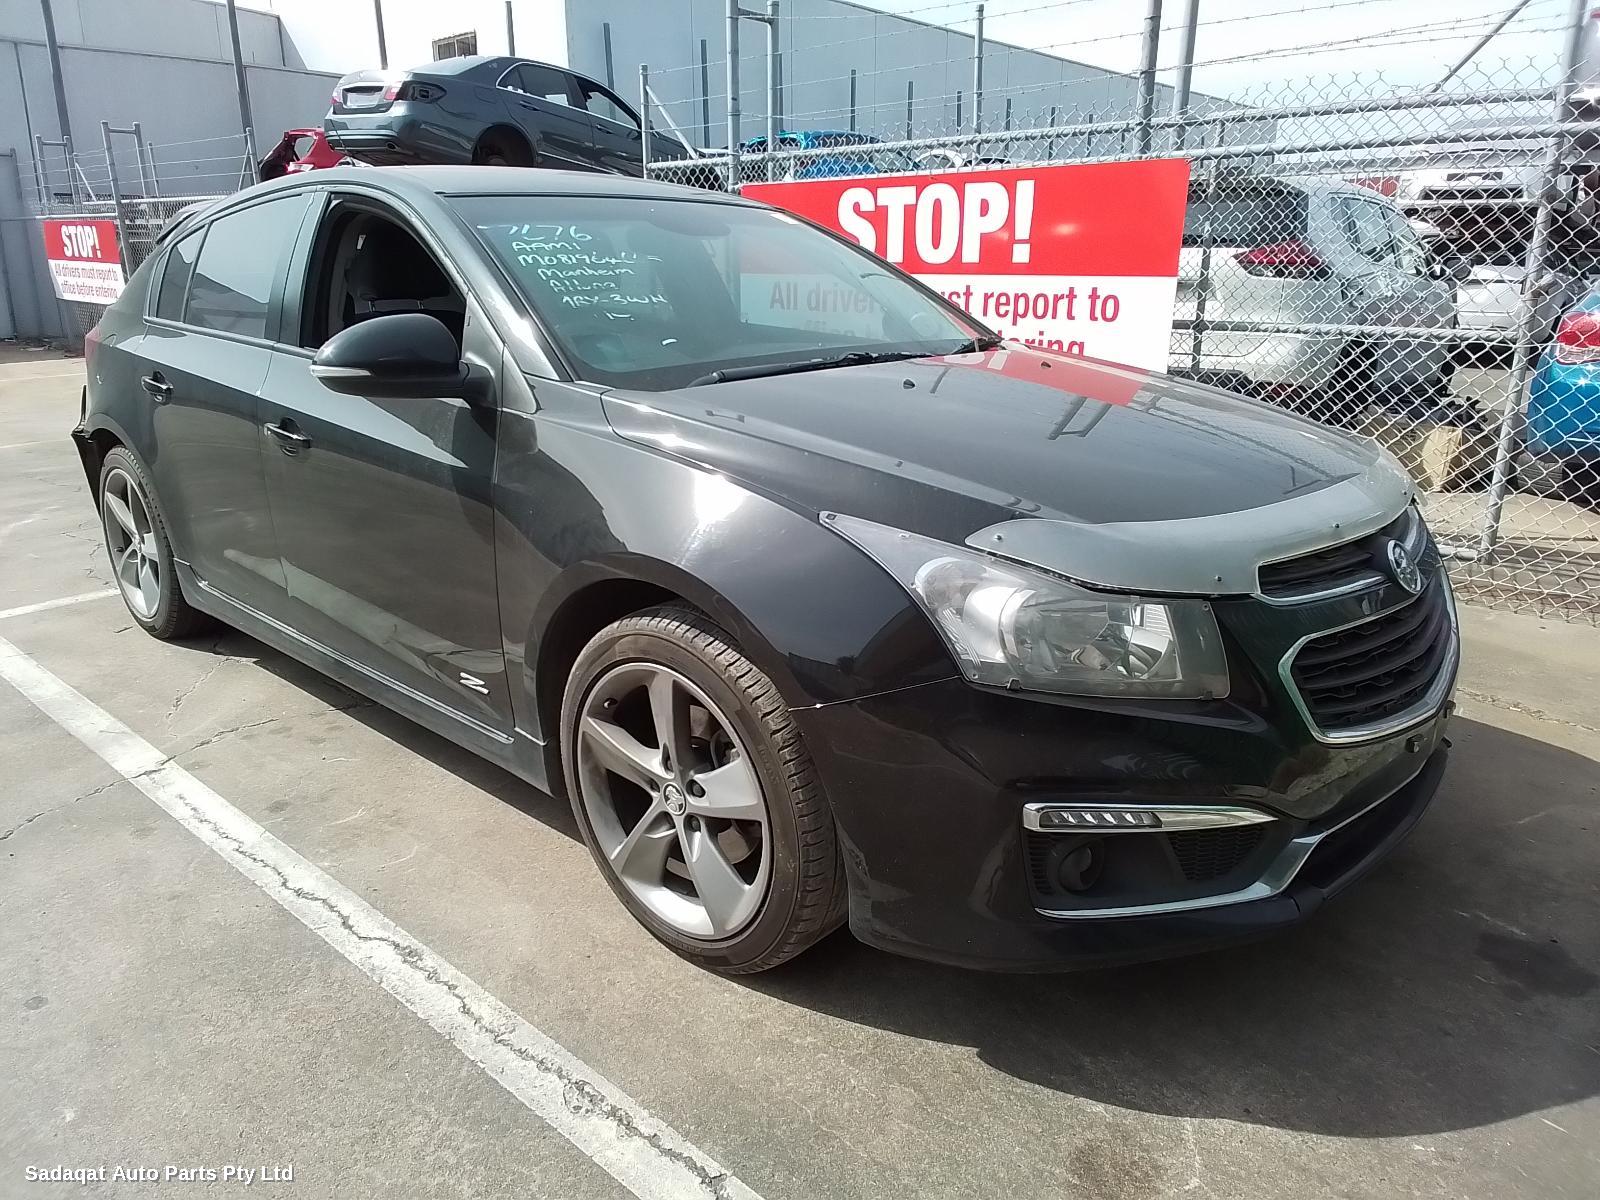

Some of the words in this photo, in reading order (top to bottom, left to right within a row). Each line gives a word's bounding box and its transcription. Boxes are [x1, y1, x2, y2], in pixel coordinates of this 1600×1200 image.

[60, 224, 102, 259] STOP!
[836, 179, 1036, 265] STOP!
[62, 263, 81, 279] drivers
[769, 280, 799, 311] All
[982, 286, 1078, 327] report
[1088, 286, 1121, 323] to
